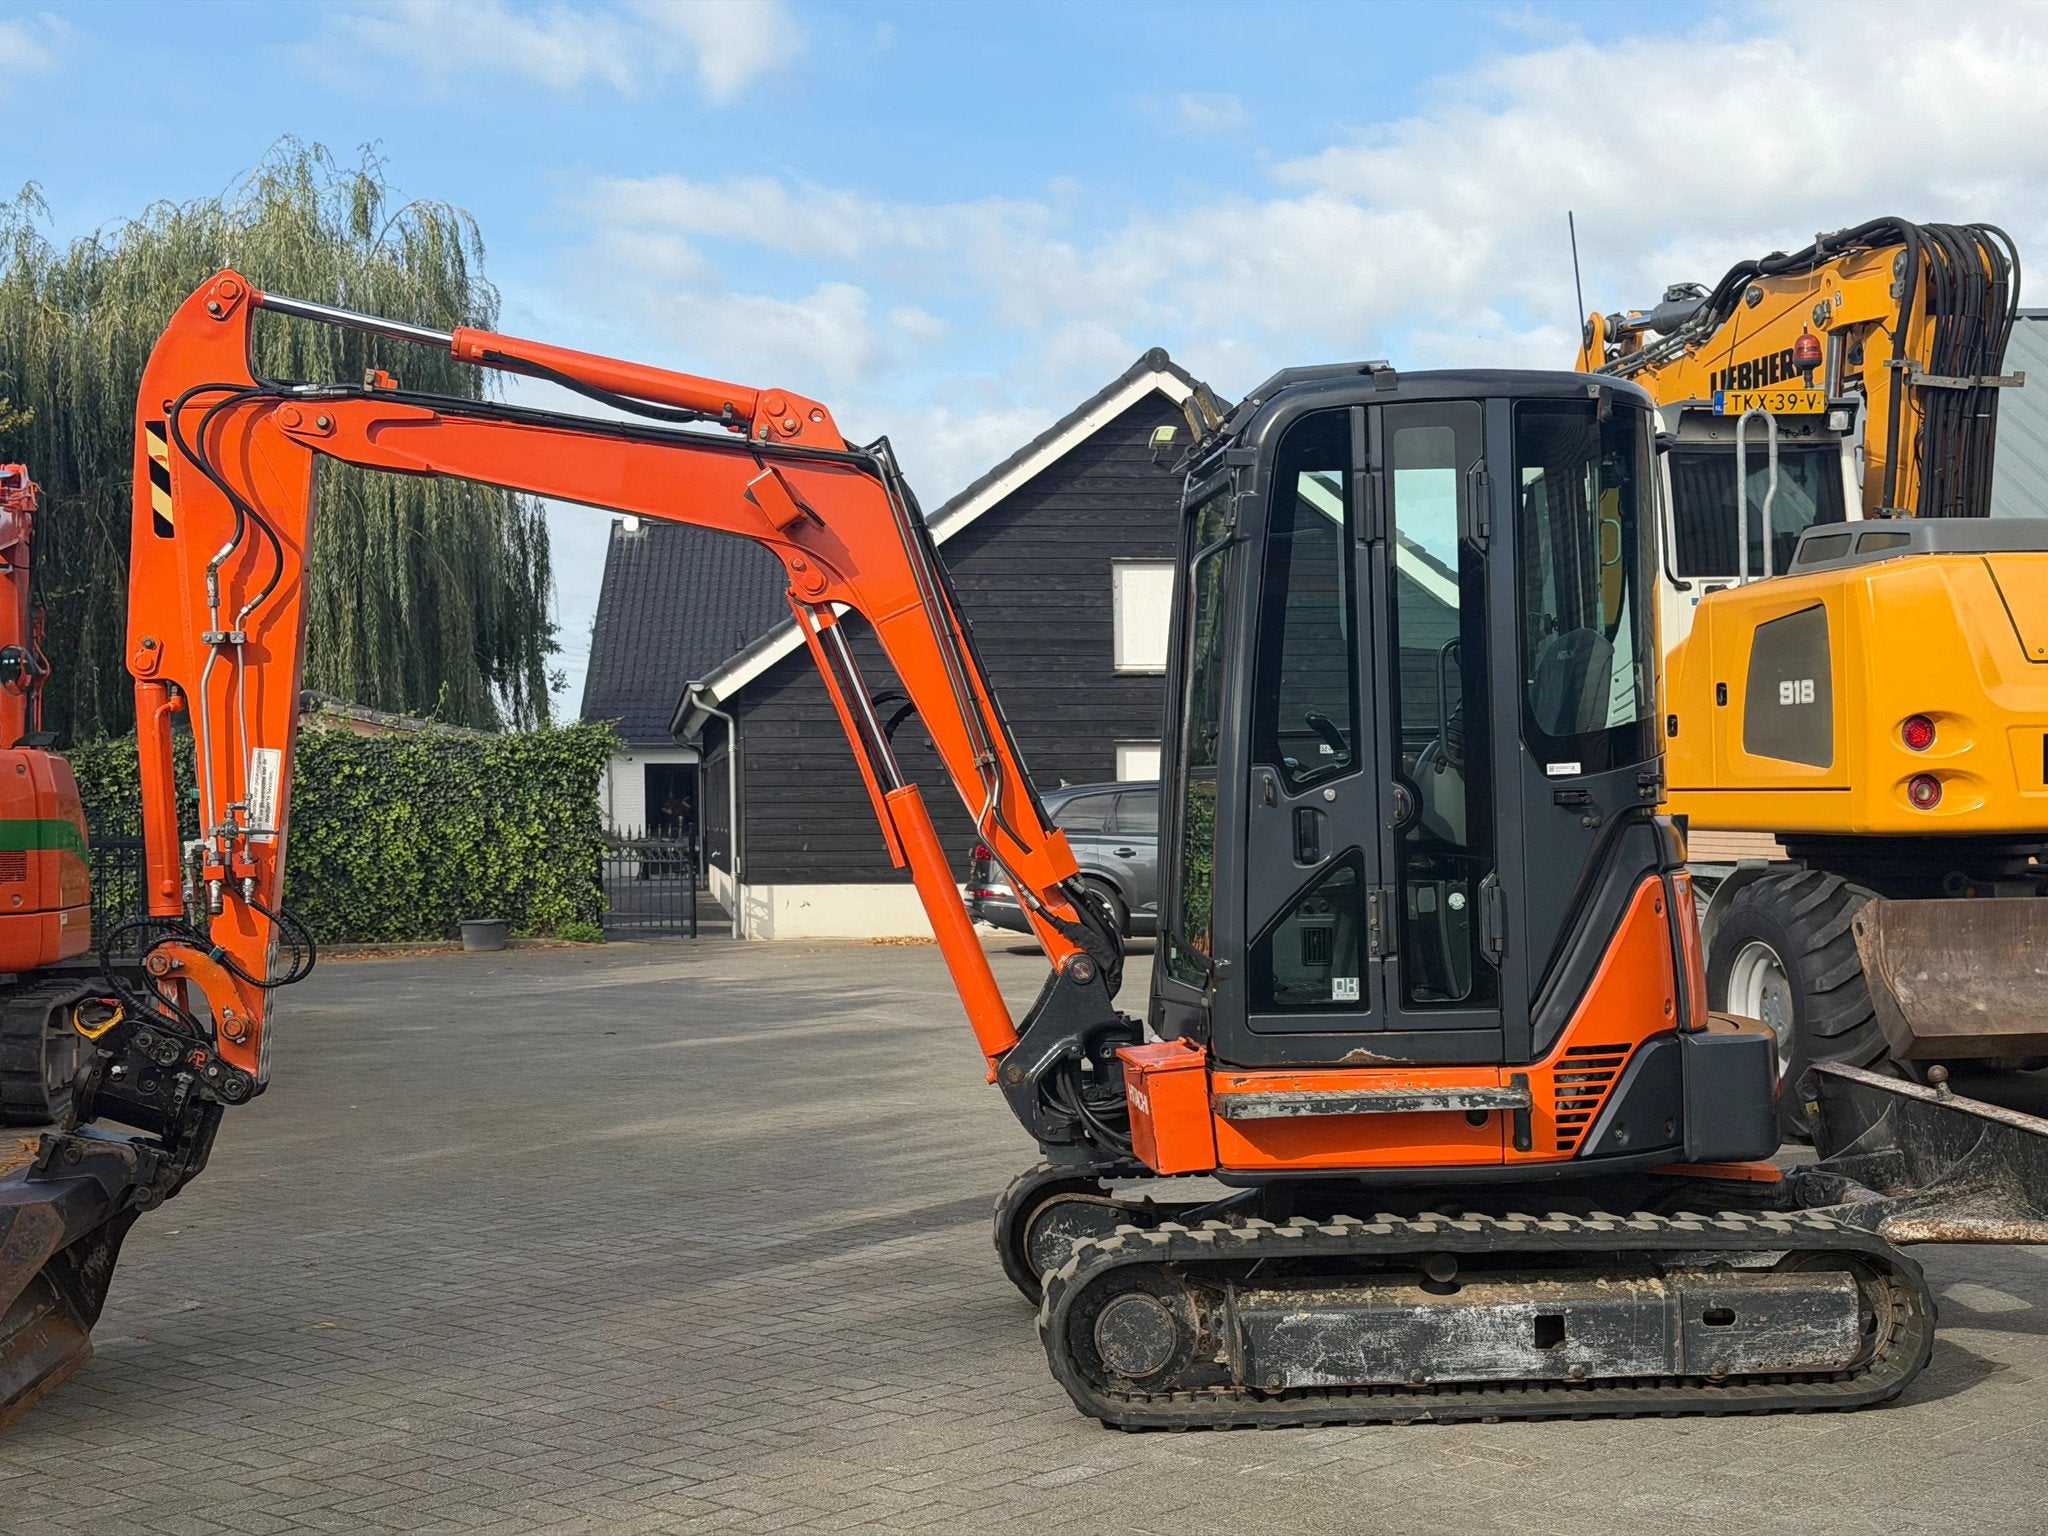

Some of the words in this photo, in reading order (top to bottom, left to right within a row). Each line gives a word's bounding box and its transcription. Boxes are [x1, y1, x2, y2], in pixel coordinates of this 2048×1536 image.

[1710, 348, 1804, 399] LIEBHER
[1731, 393, 1817, 411] TKX-39-V
[1780, 679, 1815, 705] 918
